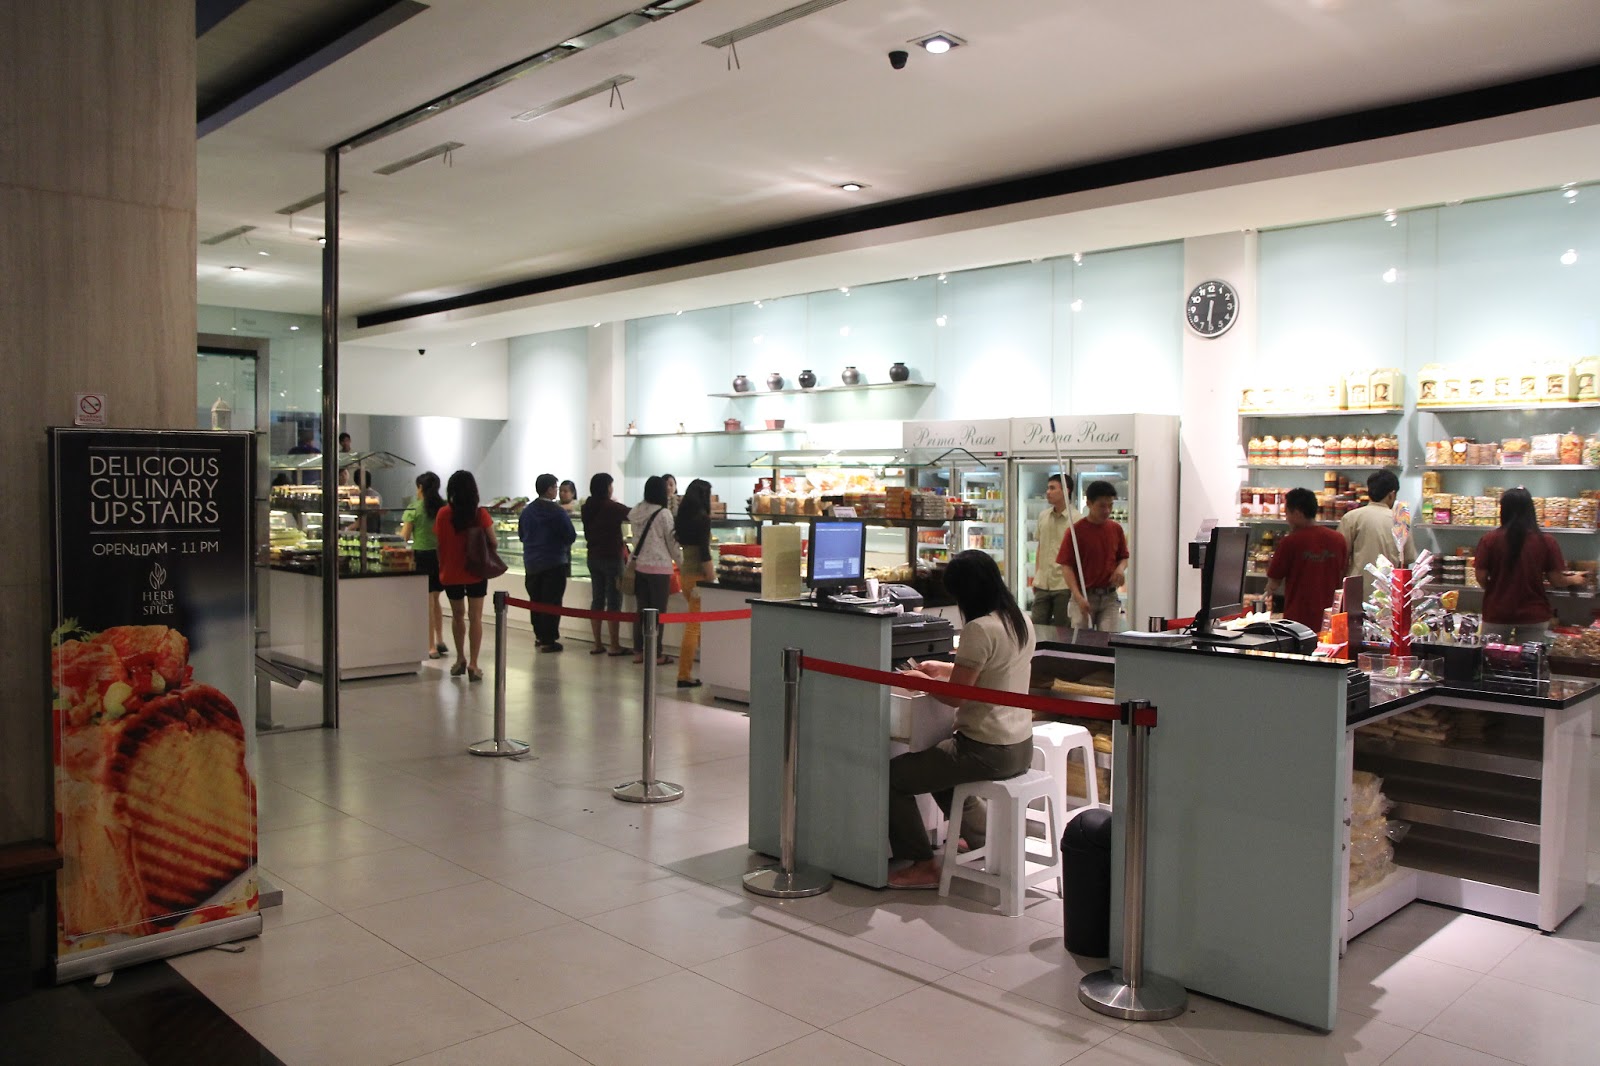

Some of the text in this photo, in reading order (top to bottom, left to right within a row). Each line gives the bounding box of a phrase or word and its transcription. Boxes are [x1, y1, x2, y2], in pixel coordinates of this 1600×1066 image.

[1199, 288, 1206, 296] 11
[913, 424, 996, 447] Prima Rasa
[1077, 420, 1120, 443] Rasa
[90, 456, 219, 477] DELICIOUS
[90, 478, 219, 499] CULINARY
[91, 501, 219, 525] UPSTAIRS
[181, 542, 197, 554] 11
[200, 541, 219, 553] PM
[142, 590, 175, 601] HERB
[143, 604, 174, 616] SPICE
